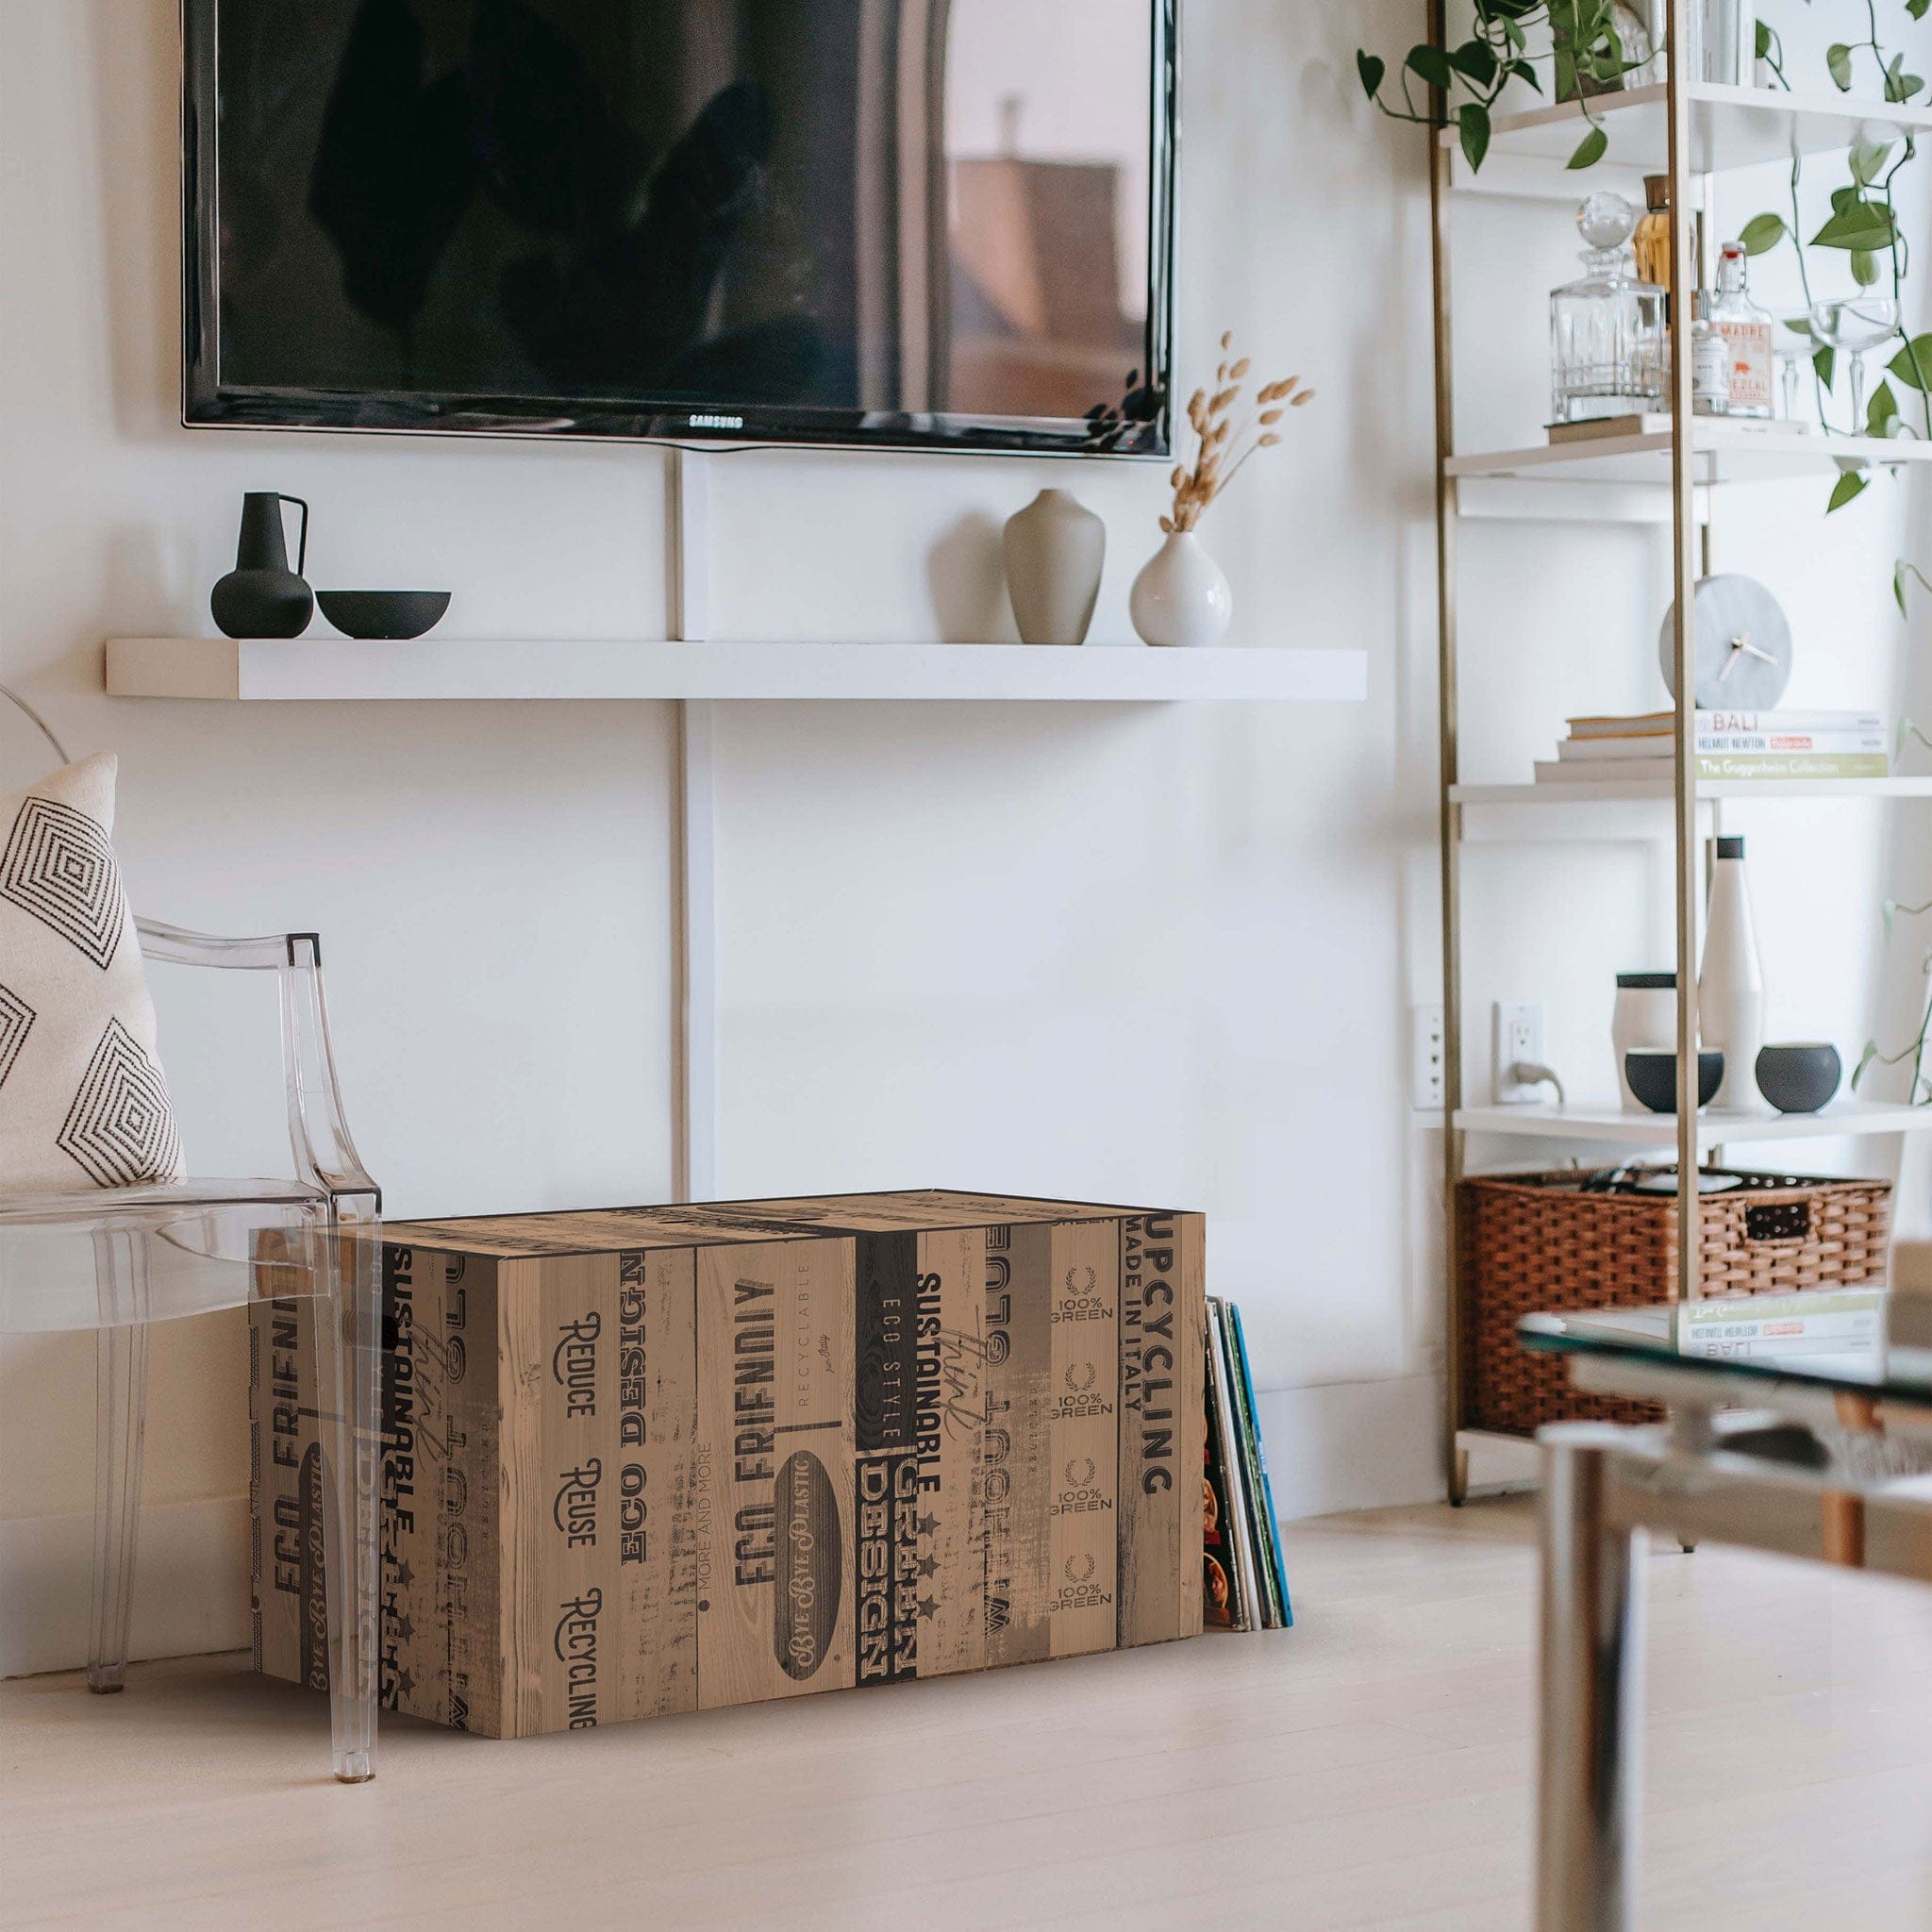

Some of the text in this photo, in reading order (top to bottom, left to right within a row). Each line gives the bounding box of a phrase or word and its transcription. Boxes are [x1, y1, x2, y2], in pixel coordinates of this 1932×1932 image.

[689, 414, 743, 428] SAMSUNG
[1698, 737, 1729, 749] HELMUT
[1732, 737, 1766, 749] NEWTON
[1701, 759, 1722, 774] The
[1713, 713, 1757, 732] BALI
[445, 1256, 466, 1385] GLU
[798, 1265, 809, 1407] RECYCLABLE
[985, 1225, 1011, 1368] GLUE
[1051, 1308, 1113, 1324] GREEN
[1058, 1297, 1103, 1310] 100%
[1124, 1216, 1142, 1412] MADE IN ITALY
[393, 1247, 414, 1534] SUSTAINABLE
[553, 1311, 601, 1419] REDUCE
[883, 1298, 901, 1439] ECO STYLE
[917, 1273, 941, 1493] SUSTAINABLE
[1058, 1393, 1102, 1407] 100%
[1141, 1214, 1174, 1495] UPCYCLING
[620, 1249, 648, 1567] ECO DESIGN
[1028, 1387, 1039, 1474] RECYCLED
[1050, 1404, 1112, 1420] GREEN
[554, 1457, 602, 1549] REUSE
[698, 1442, 712, 1590] MORE AND MORE
[1050, 1498, 1112, 1516] GREEN
[1058, 1489, 1102, 1502] 100%
[789, 1459, 816, 1668] BYE BYE PLASTIC
[860, 1461, 889, 1680] DESIGN
[894, 1457, 920, 1675] GREEN
[1049, 1593, 1111, 1611] GREEN
[1058, 1584, 1102, 1599] 100%
